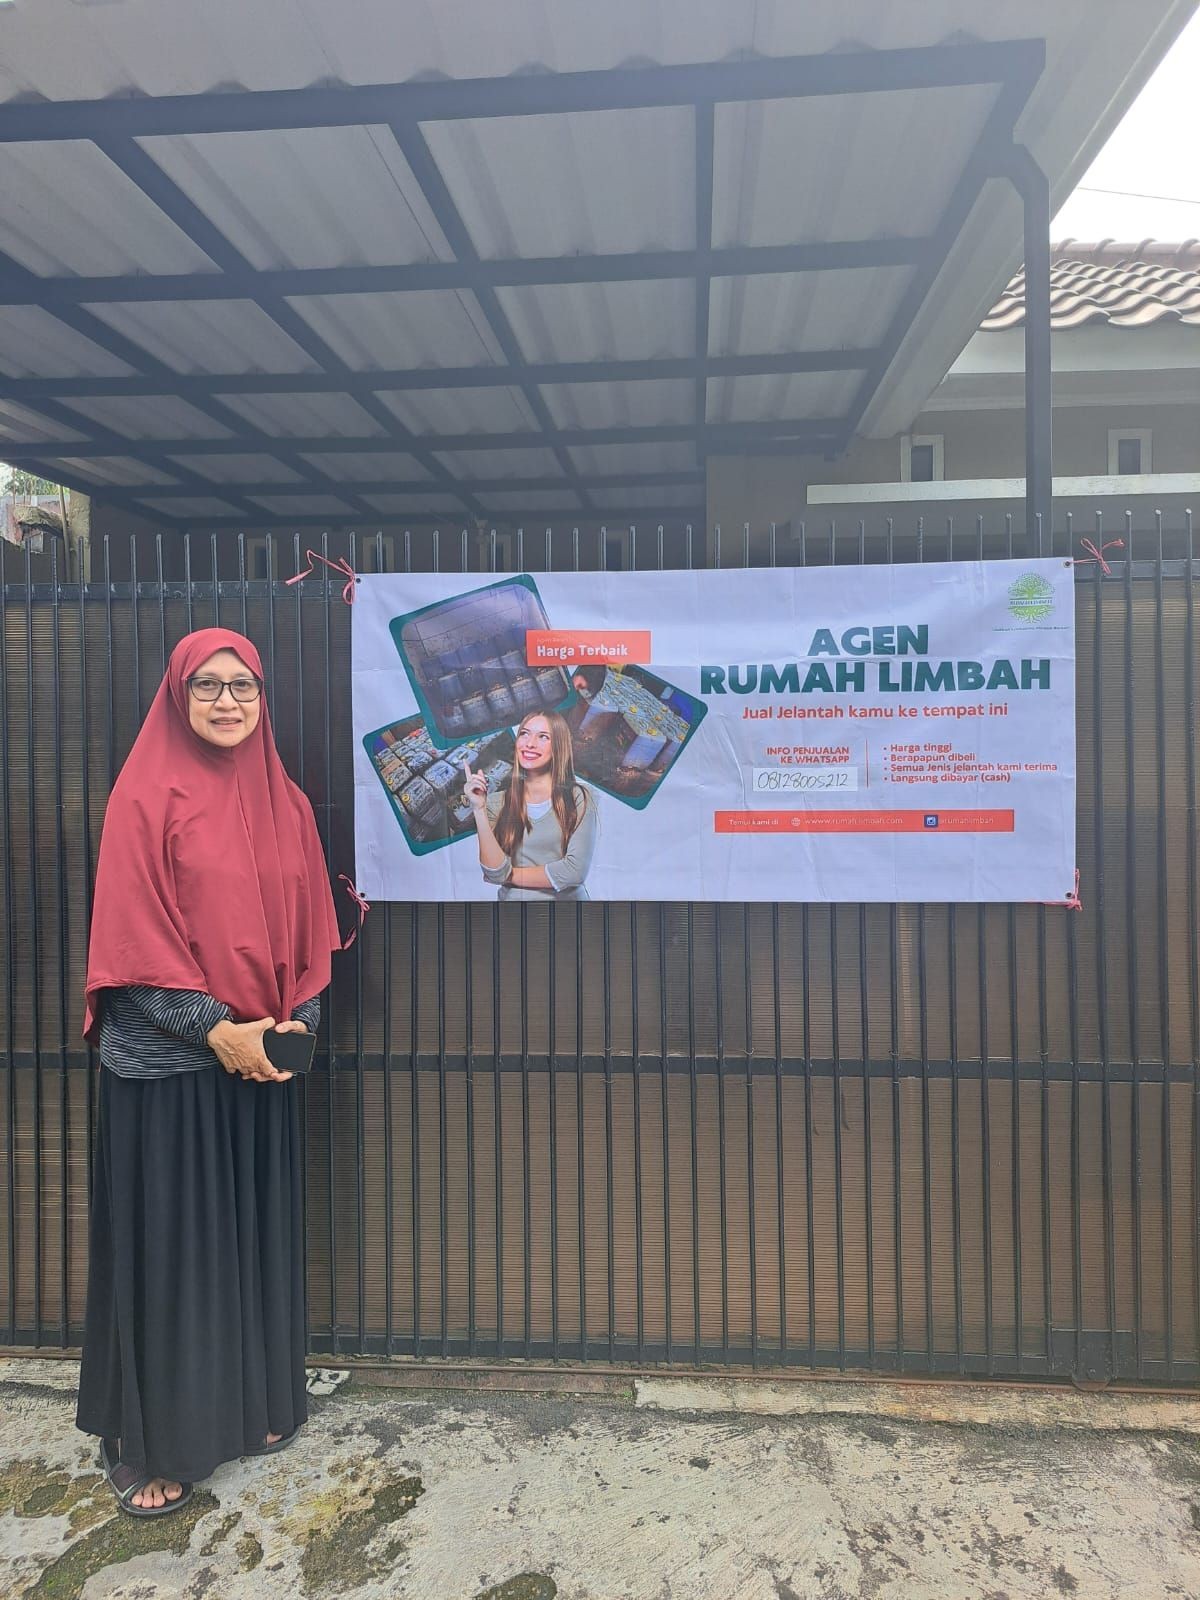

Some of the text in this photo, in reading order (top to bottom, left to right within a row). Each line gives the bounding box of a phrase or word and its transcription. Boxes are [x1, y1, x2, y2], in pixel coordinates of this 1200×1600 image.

[807, 624, 929, 656] AGEN
[537, 644, 628, 660] Harga Terbaik
[700, 659, 1051, 695] RUMAH LIMBAH
[742, 702, 1009, 720] Jual Jelantah kamu ke tempat ini
[766, 746, 850, 755] INFO PENJUALAN
[890, 742, 953, 753] Harga tinggi
[780, 755, 850, 764] KE WHATSAPP
[890, 753, 976, 763] Berapapun dibeli
[890, 762, 1058, 773] Semua Jenis jelantah kami terima
[890, 772, 1011, 783] Langsung dibayar (cash)
